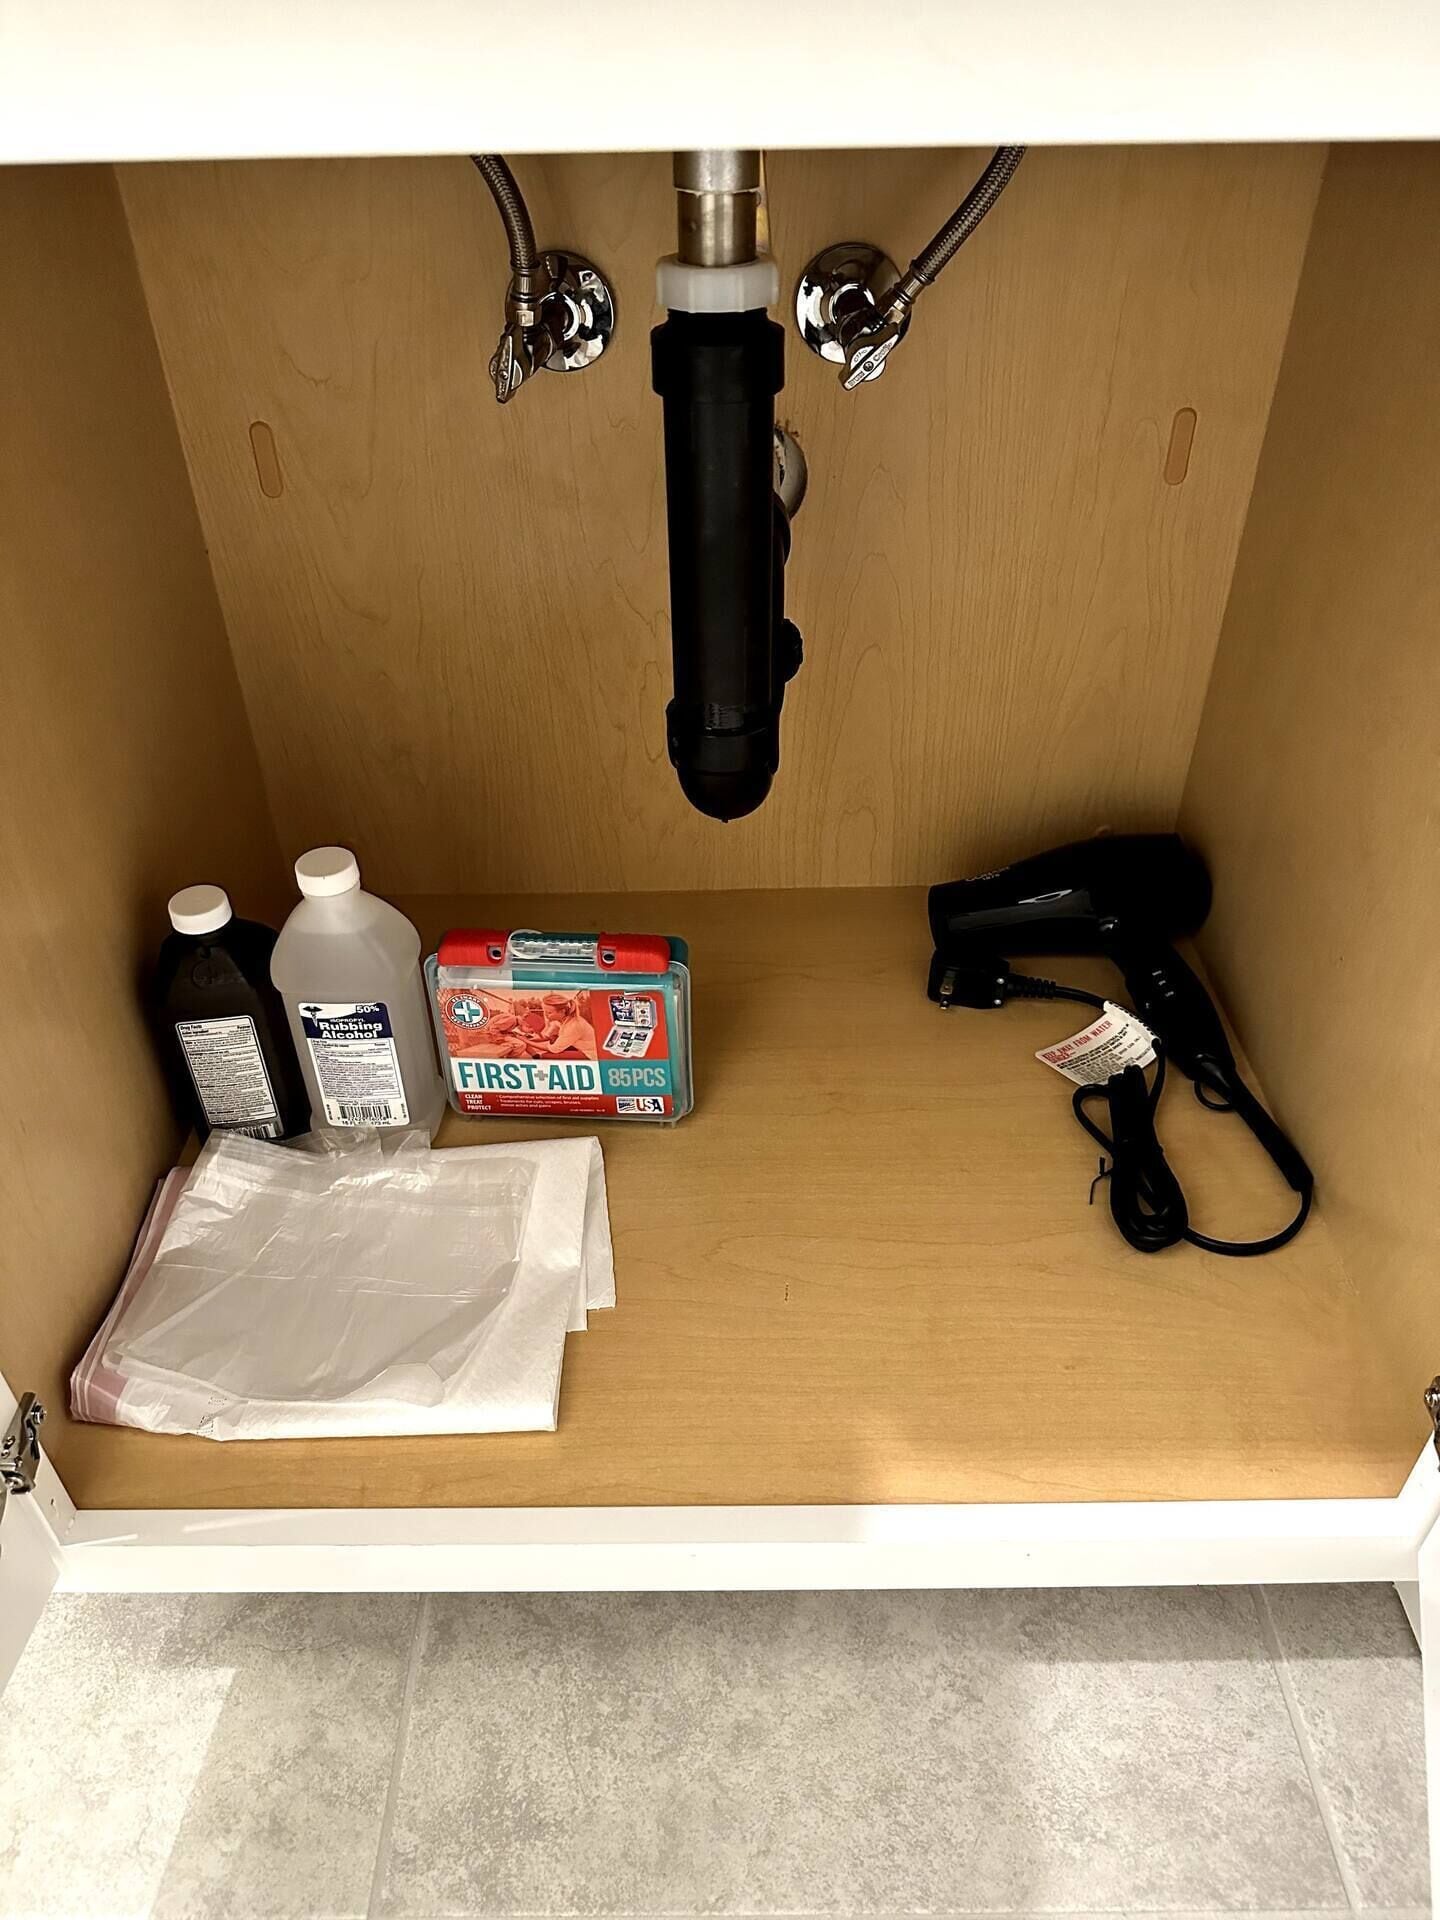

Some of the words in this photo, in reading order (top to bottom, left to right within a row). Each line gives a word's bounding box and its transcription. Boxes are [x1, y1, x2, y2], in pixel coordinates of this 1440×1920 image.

[356, 1005, 380, 1014] 50%
[319, 1021, 383, 1032] Rubbing
[321, 1029, 378, 1039] Alcohol
[1073, 1034, 1094, 1048] FROM
[1091, 1020, 1113, 1037] WATER
[458, 1062, 537, 1090] FIRST
[548, 1064, 595, 1091] AID
[607, 1067, 666, 1088] 85PCS
[635, 1098, 662, 1112] USA
